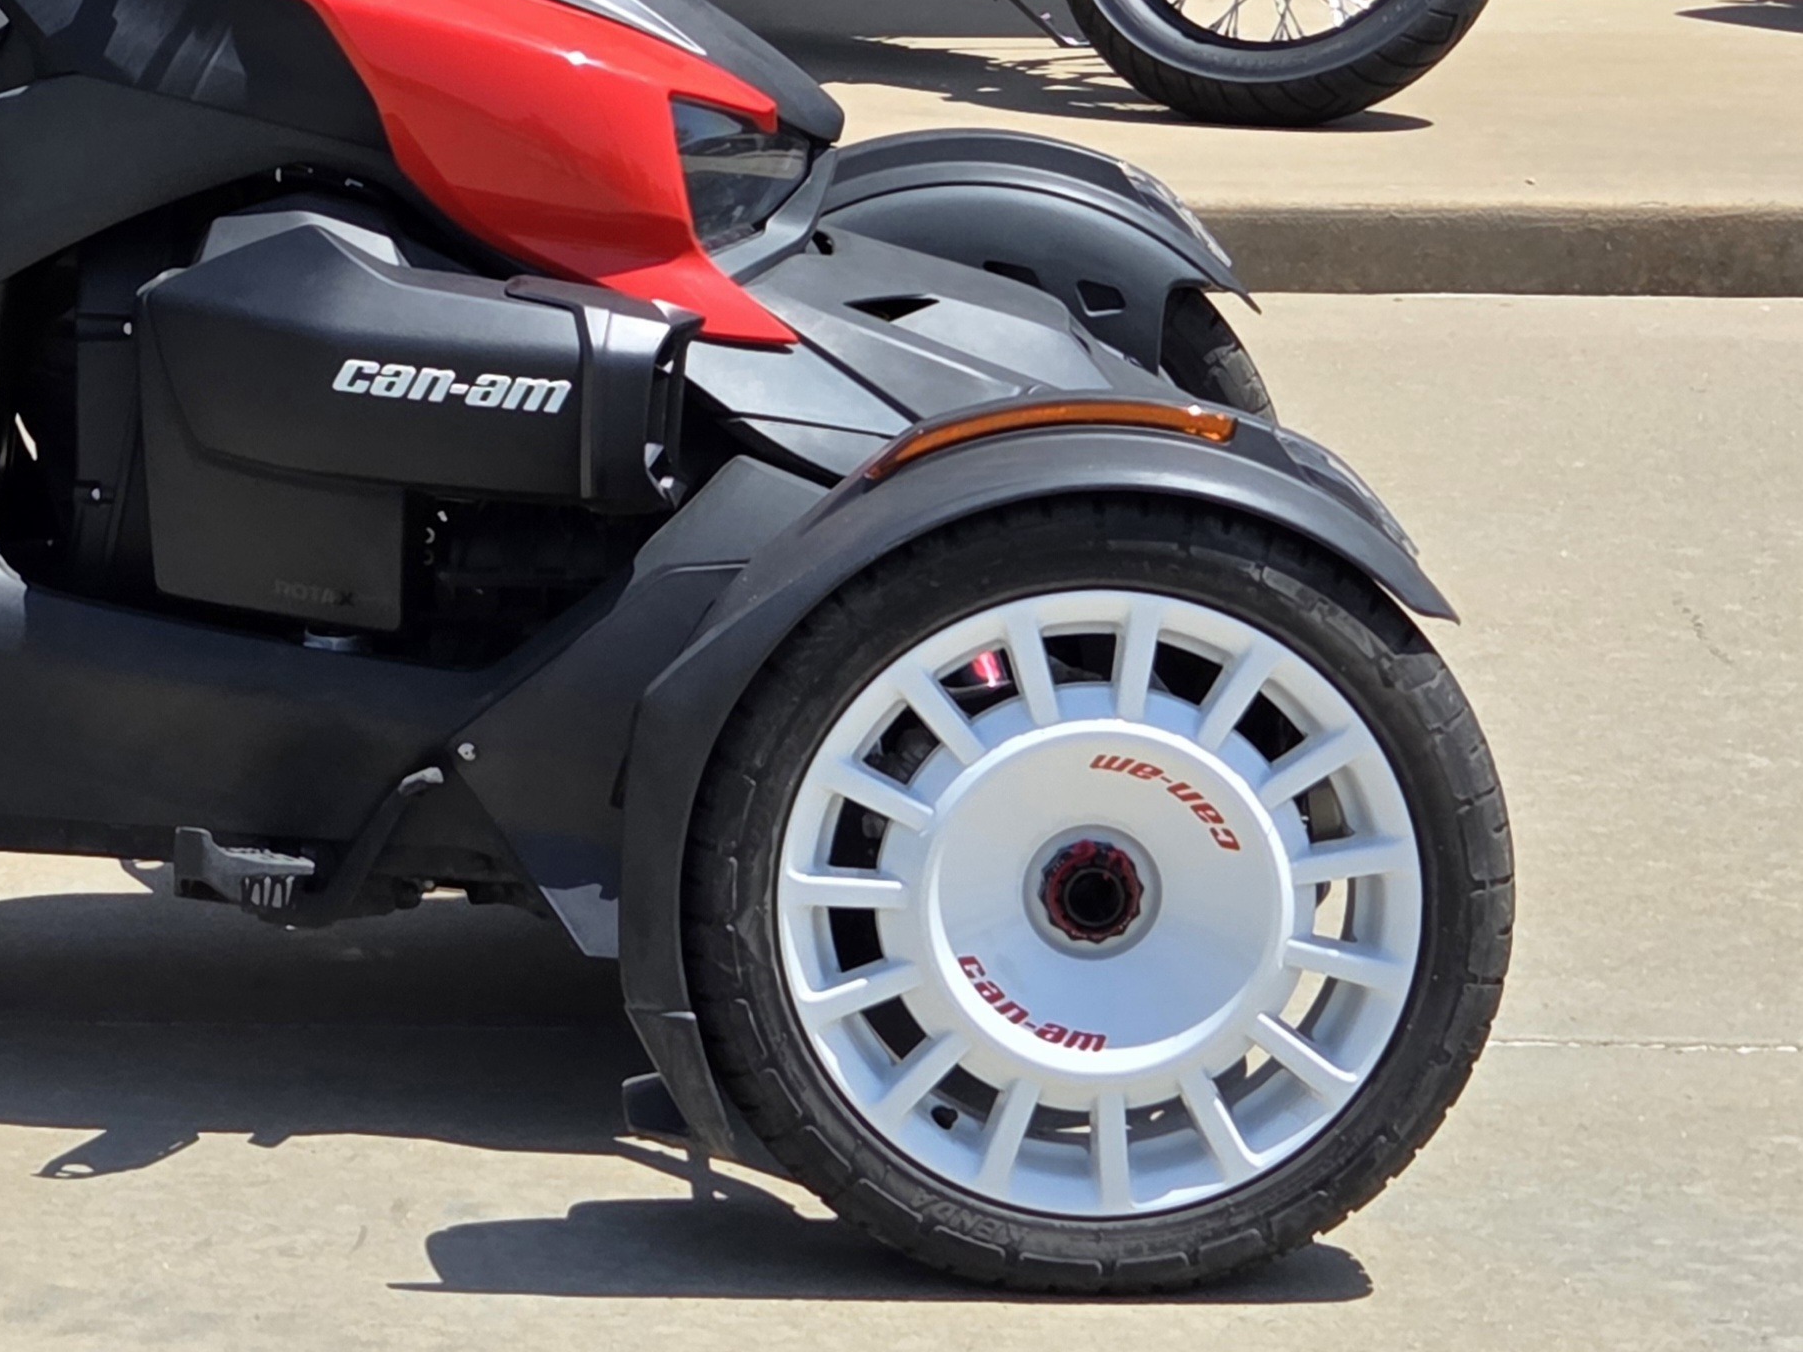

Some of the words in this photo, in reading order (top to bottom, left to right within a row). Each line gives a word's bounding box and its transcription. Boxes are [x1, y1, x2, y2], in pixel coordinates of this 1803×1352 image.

[332, 357, 573, 416] can-am
[1089, 752, 1242, 854] can-am
[957, 953, 1107, 1053] can-am
